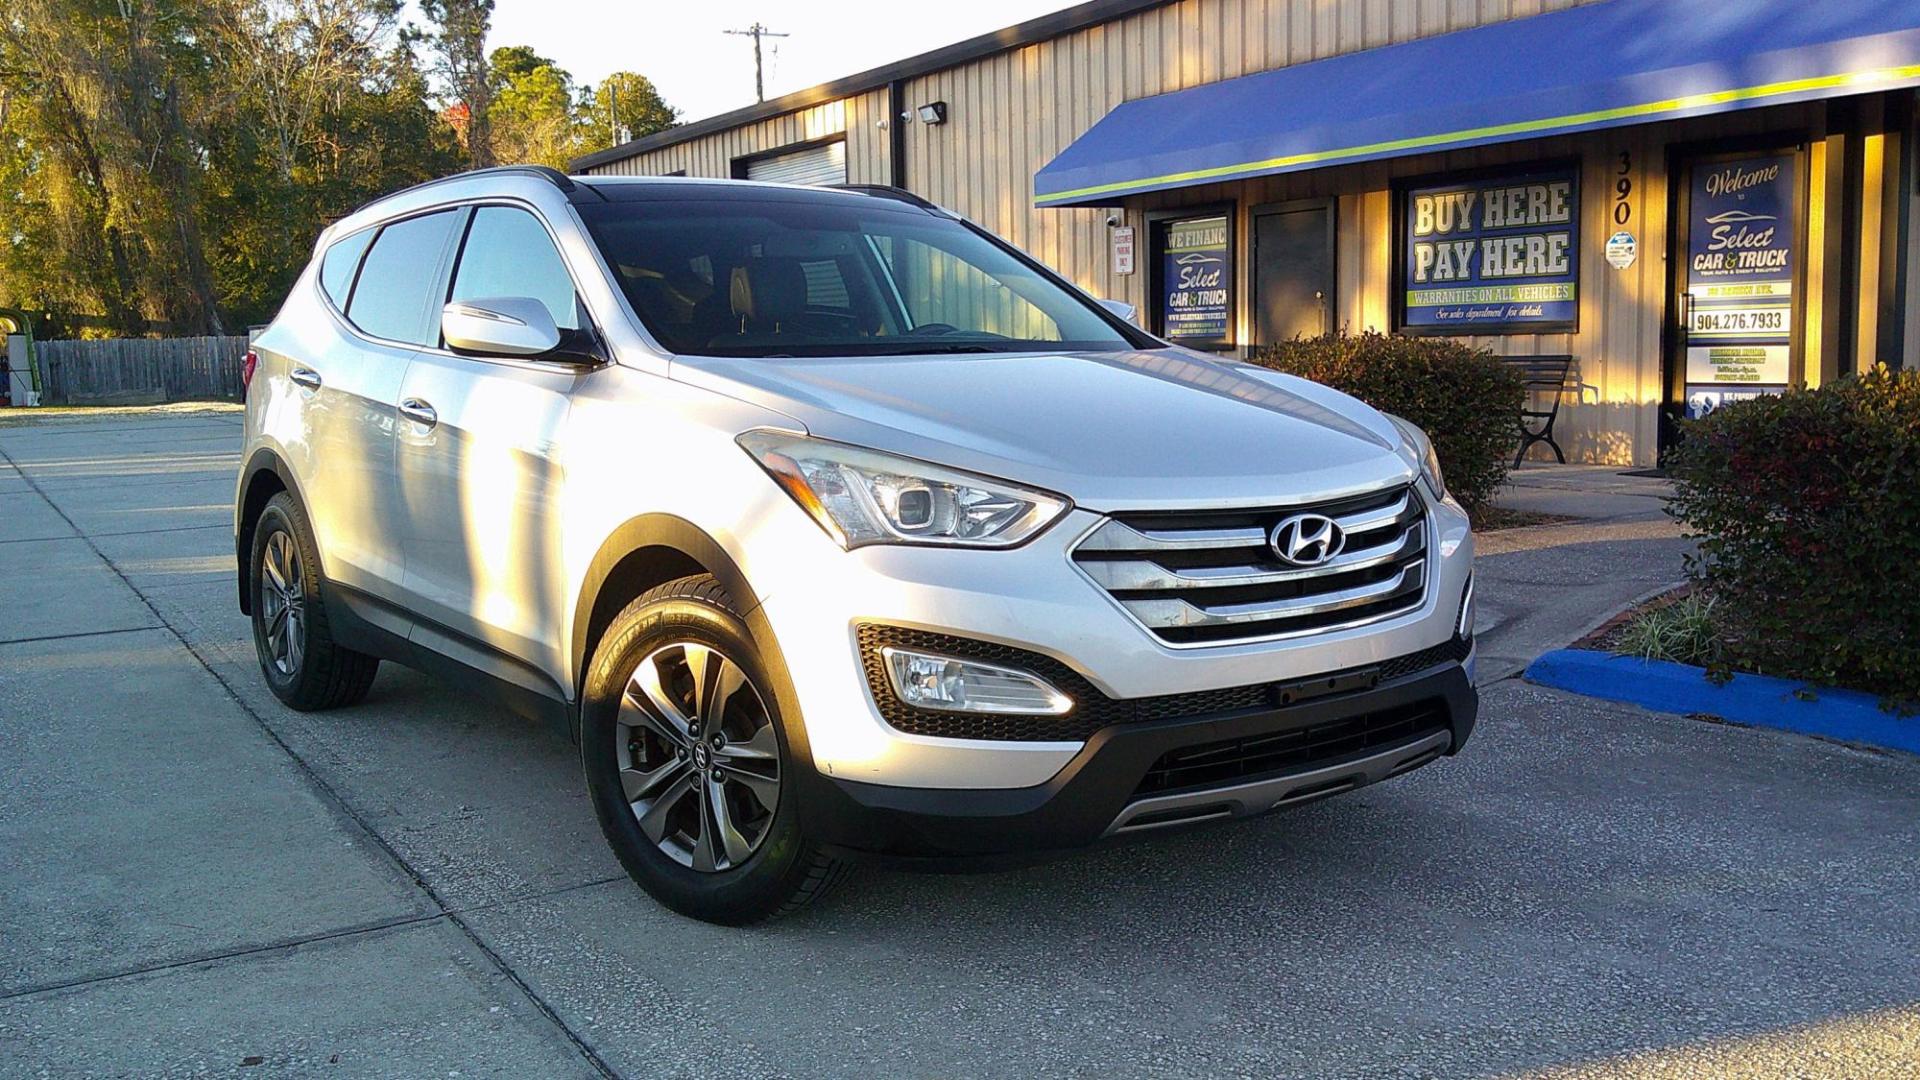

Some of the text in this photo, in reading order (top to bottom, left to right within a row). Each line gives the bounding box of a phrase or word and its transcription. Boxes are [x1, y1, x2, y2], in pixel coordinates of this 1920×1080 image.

[1706, 164, 1779, 198] Welcome
[1414, 182, 1570, 236] BUY HERE
[1167, 228, 1227, 249] WE FINANC
[1708, 224, 1774, 251] Select
[1413, 233, 1570, 282] PAY HERE
[1694, 249, 1789, 271] CAR & TRUCK
[1178, 266, 1220, 289] Select
[1169, 292, 1189, 307] CAR
[1188, 291, 1197, 306] &
[1414, 286, 1569, 304] WARRANTIES ON ALL VEHICLES
[1436, 308, 1447, 320] See
[1465, 307, 1502, 323] department
[1504, 305, 1518, 320] for
[1697, 312, 1782, 330] 904.276.7933
